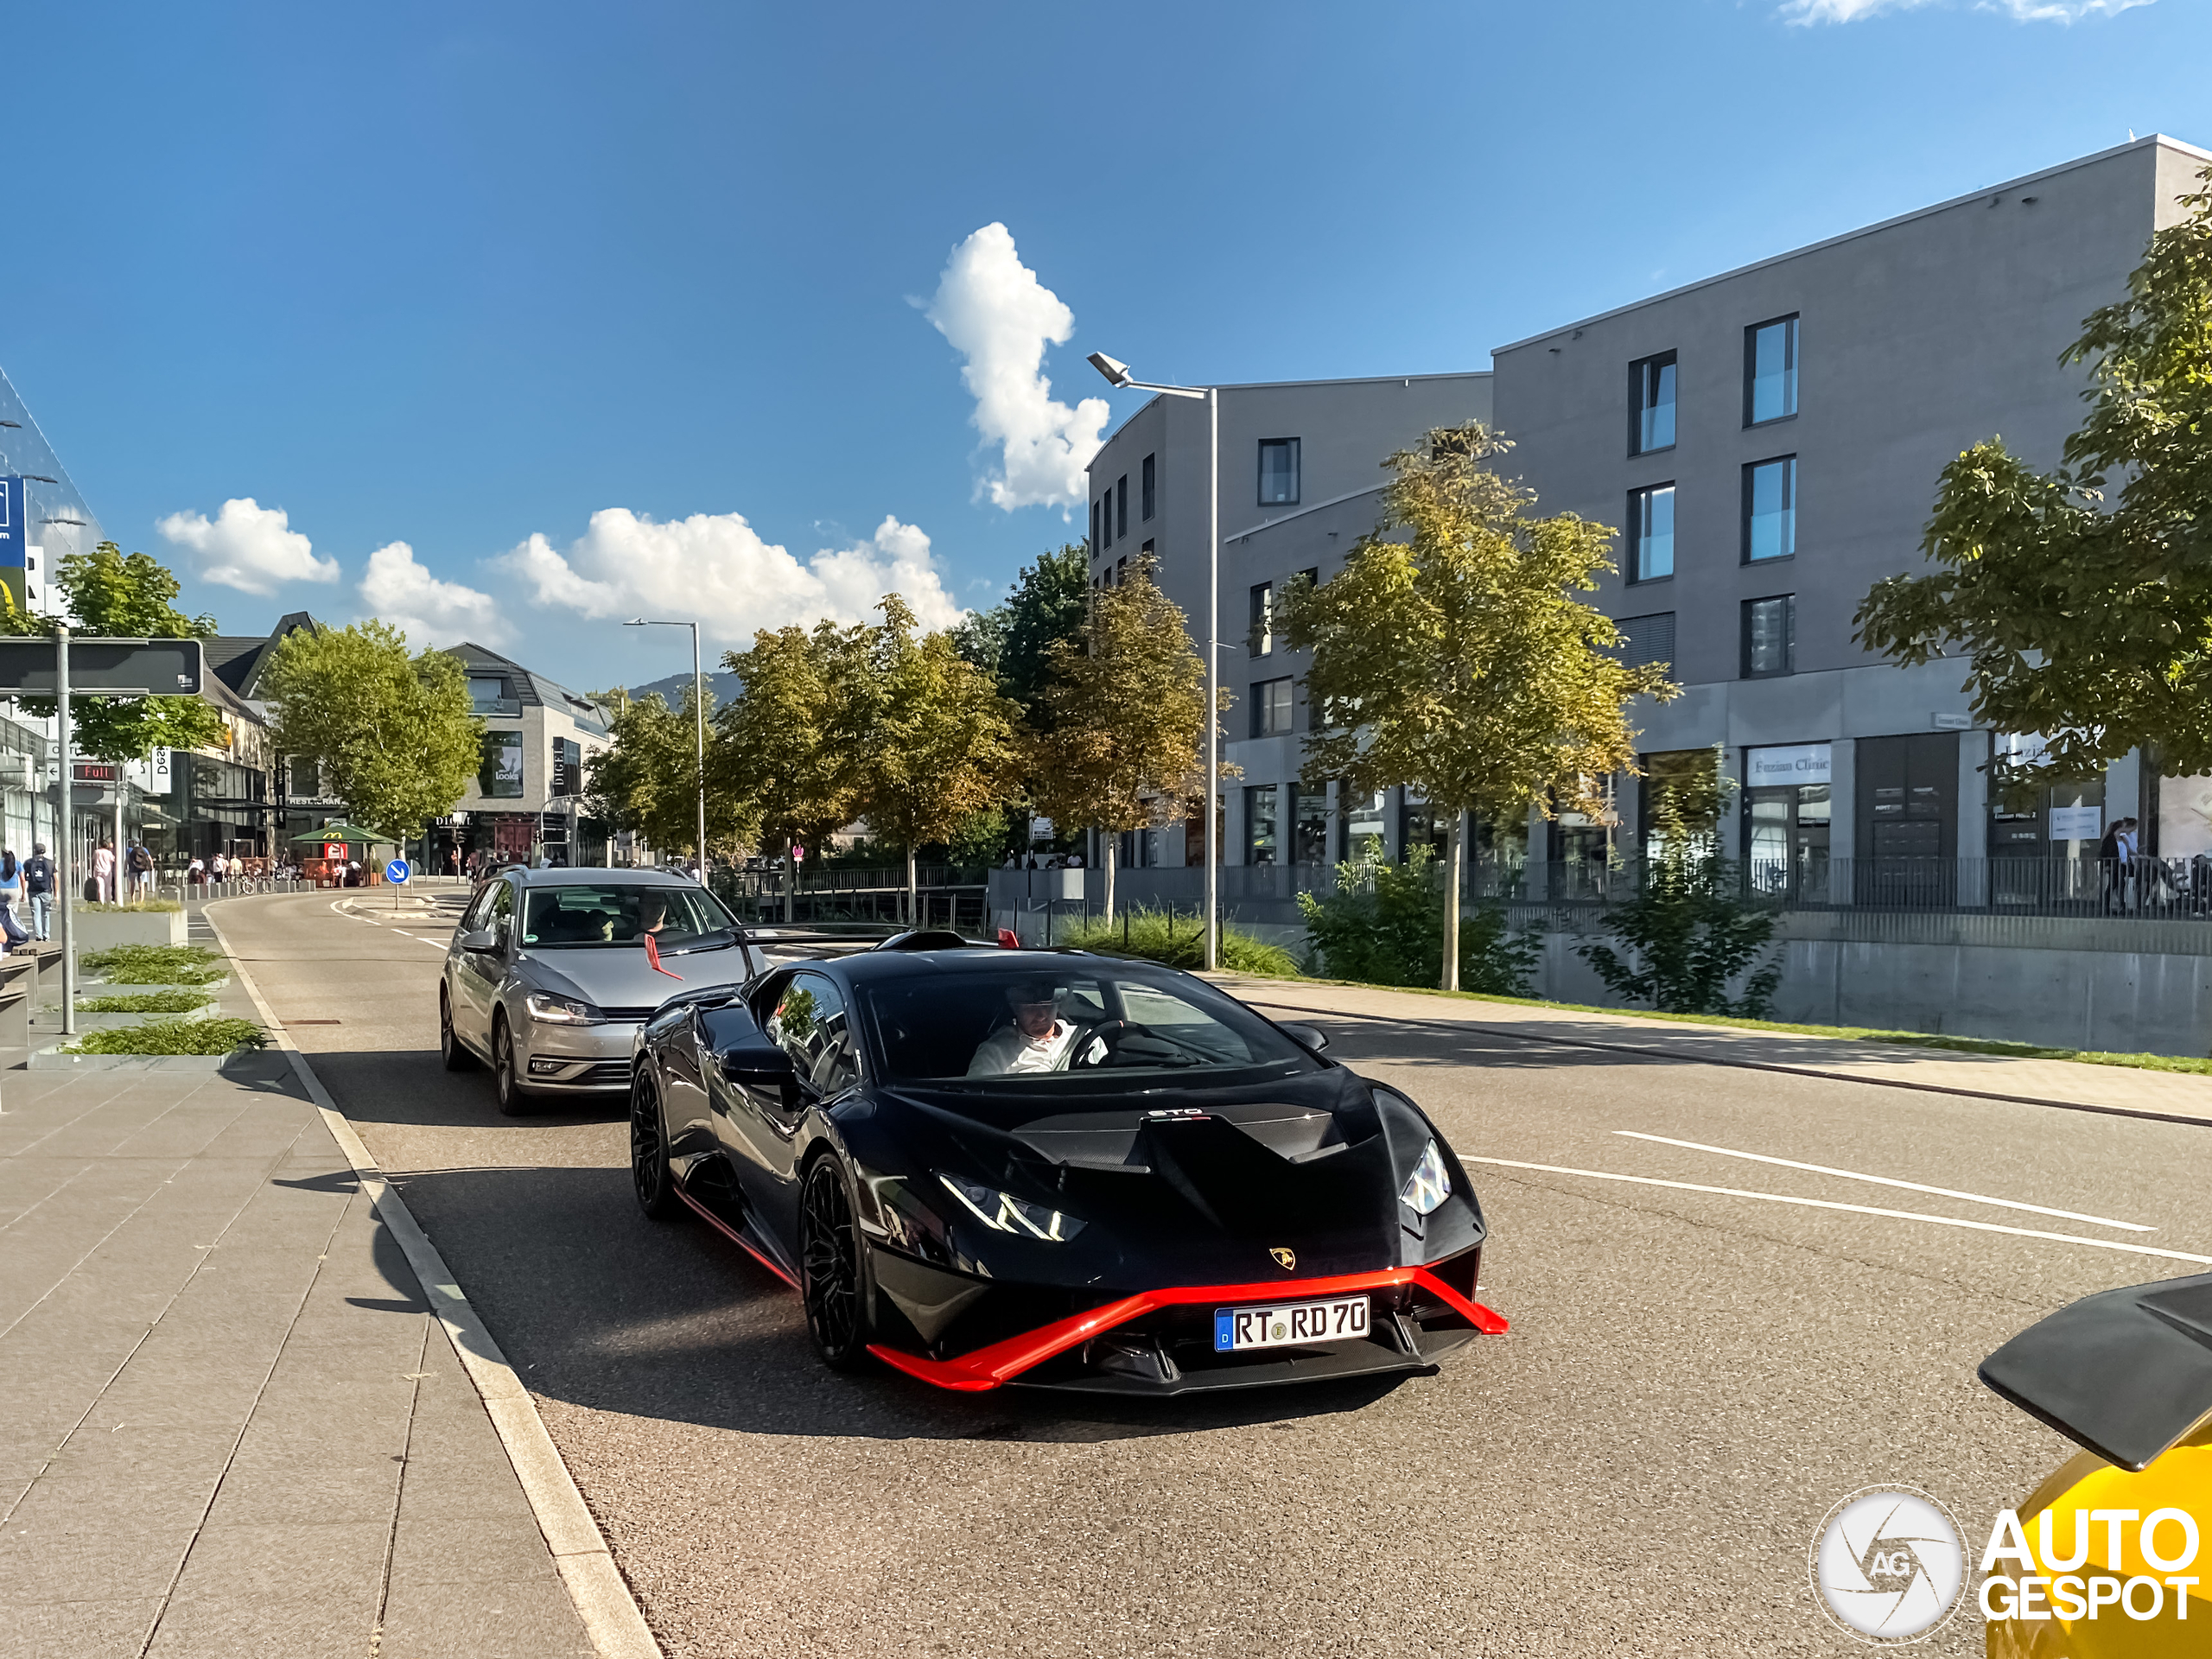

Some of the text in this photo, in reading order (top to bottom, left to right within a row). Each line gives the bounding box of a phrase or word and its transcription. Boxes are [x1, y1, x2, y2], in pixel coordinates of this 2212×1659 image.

[554, 747, 564, 785] DIGEL
[1795, 758, 1830, 771] Clinic
[85, 766, 109, 778] Full
[495, 771, 519, 780] looks
[1236, 1311, 1273, 1344] RT
[1221, 1333, 1229, 1344] D
